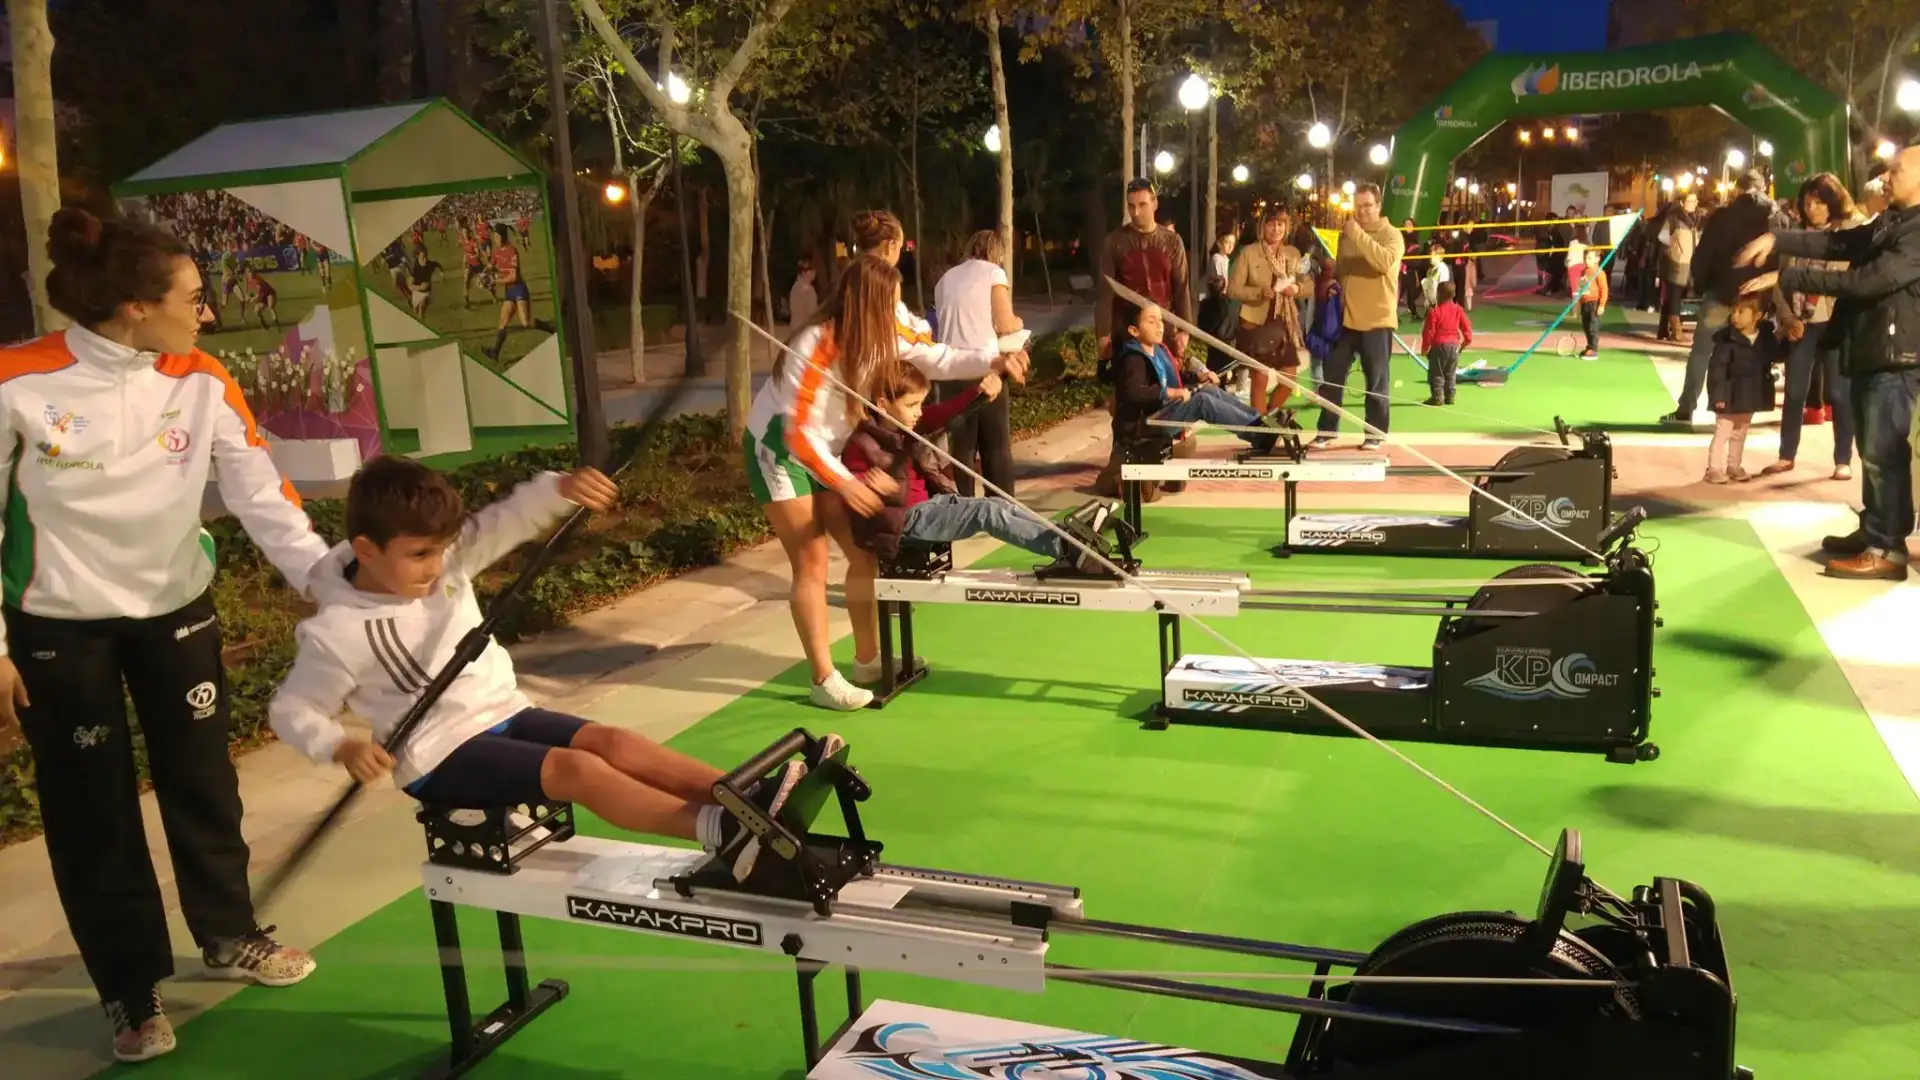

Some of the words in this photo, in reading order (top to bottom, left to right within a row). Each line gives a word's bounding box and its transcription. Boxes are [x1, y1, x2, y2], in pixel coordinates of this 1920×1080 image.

[1561, 61, 1702, 91] IBERDROLA
[1189, 469, 1273, 479] KAYAKPRO
[1301, 531, 1386, 541] KAYAKPRO
[967, 590, 1079, 604] KAYAKPRO
[1184, 690, 1306, 708] KAYAKPRO
[570, 899, 758, 941] KAYAKPRO
